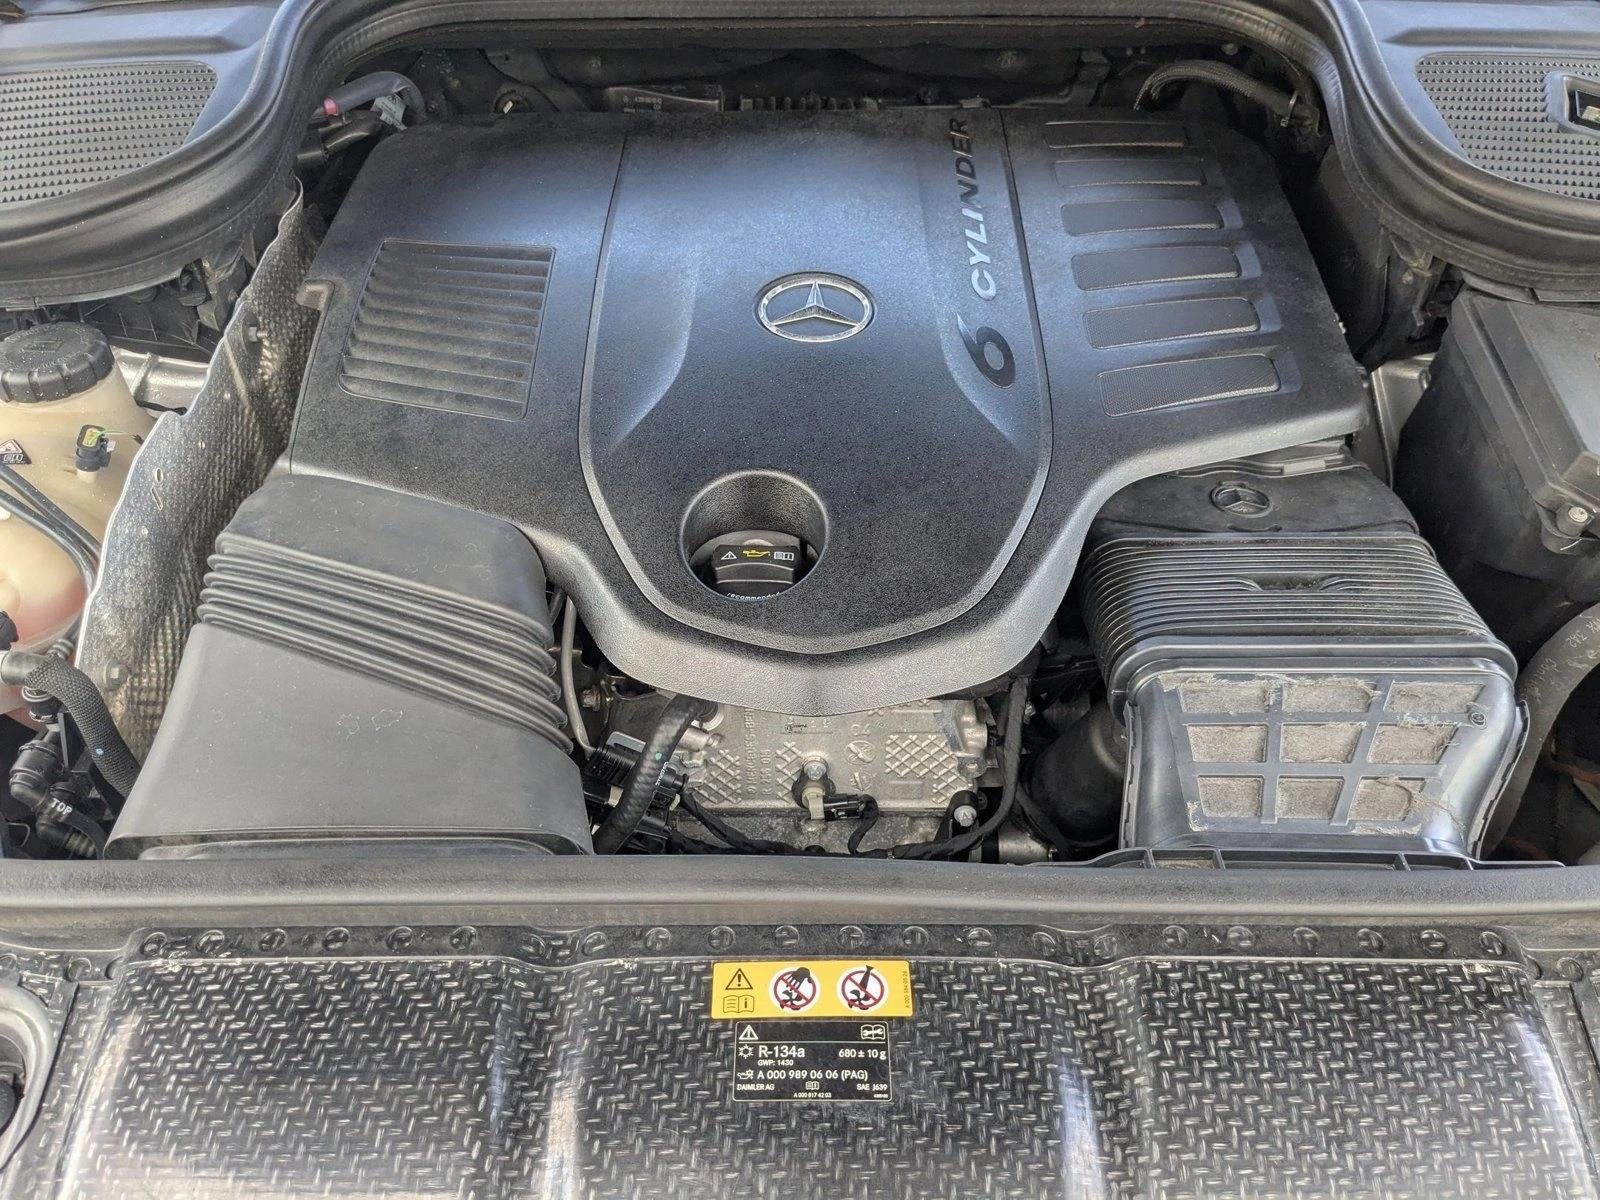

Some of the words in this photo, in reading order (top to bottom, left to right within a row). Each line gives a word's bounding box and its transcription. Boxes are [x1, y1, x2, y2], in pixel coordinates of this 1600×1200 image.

[950, 118, 997, 300] CYLINDER
[957, 313, 1016, 389] 6
[744, 708, 757, 785] MERCEDES-BEN
[51, 797, 73, 815] TOP
[758, 1045, 805, 1058] R-134a
[838, 1048, 857, 1058] 680
[867, 1048, 879, 1058] 10
[879, 1050, 887, 1060] g
[757, 1070, 765, 1079] A
[766, 1069, 786, 1079] 000
[788, 1069, 808, 1079] 989
[809, 1069, 823, 1079] 06
[825, 1069, 839, 1079] 06
[841, 1069, 869, 1081] (PAG)
[736, 1083, 765, 1091] DAIMLER
[765, 1083, 775, 1091] AG
[856, 1083, 871, 1091] SAE
[872, 1083, 888, 1091] J639
